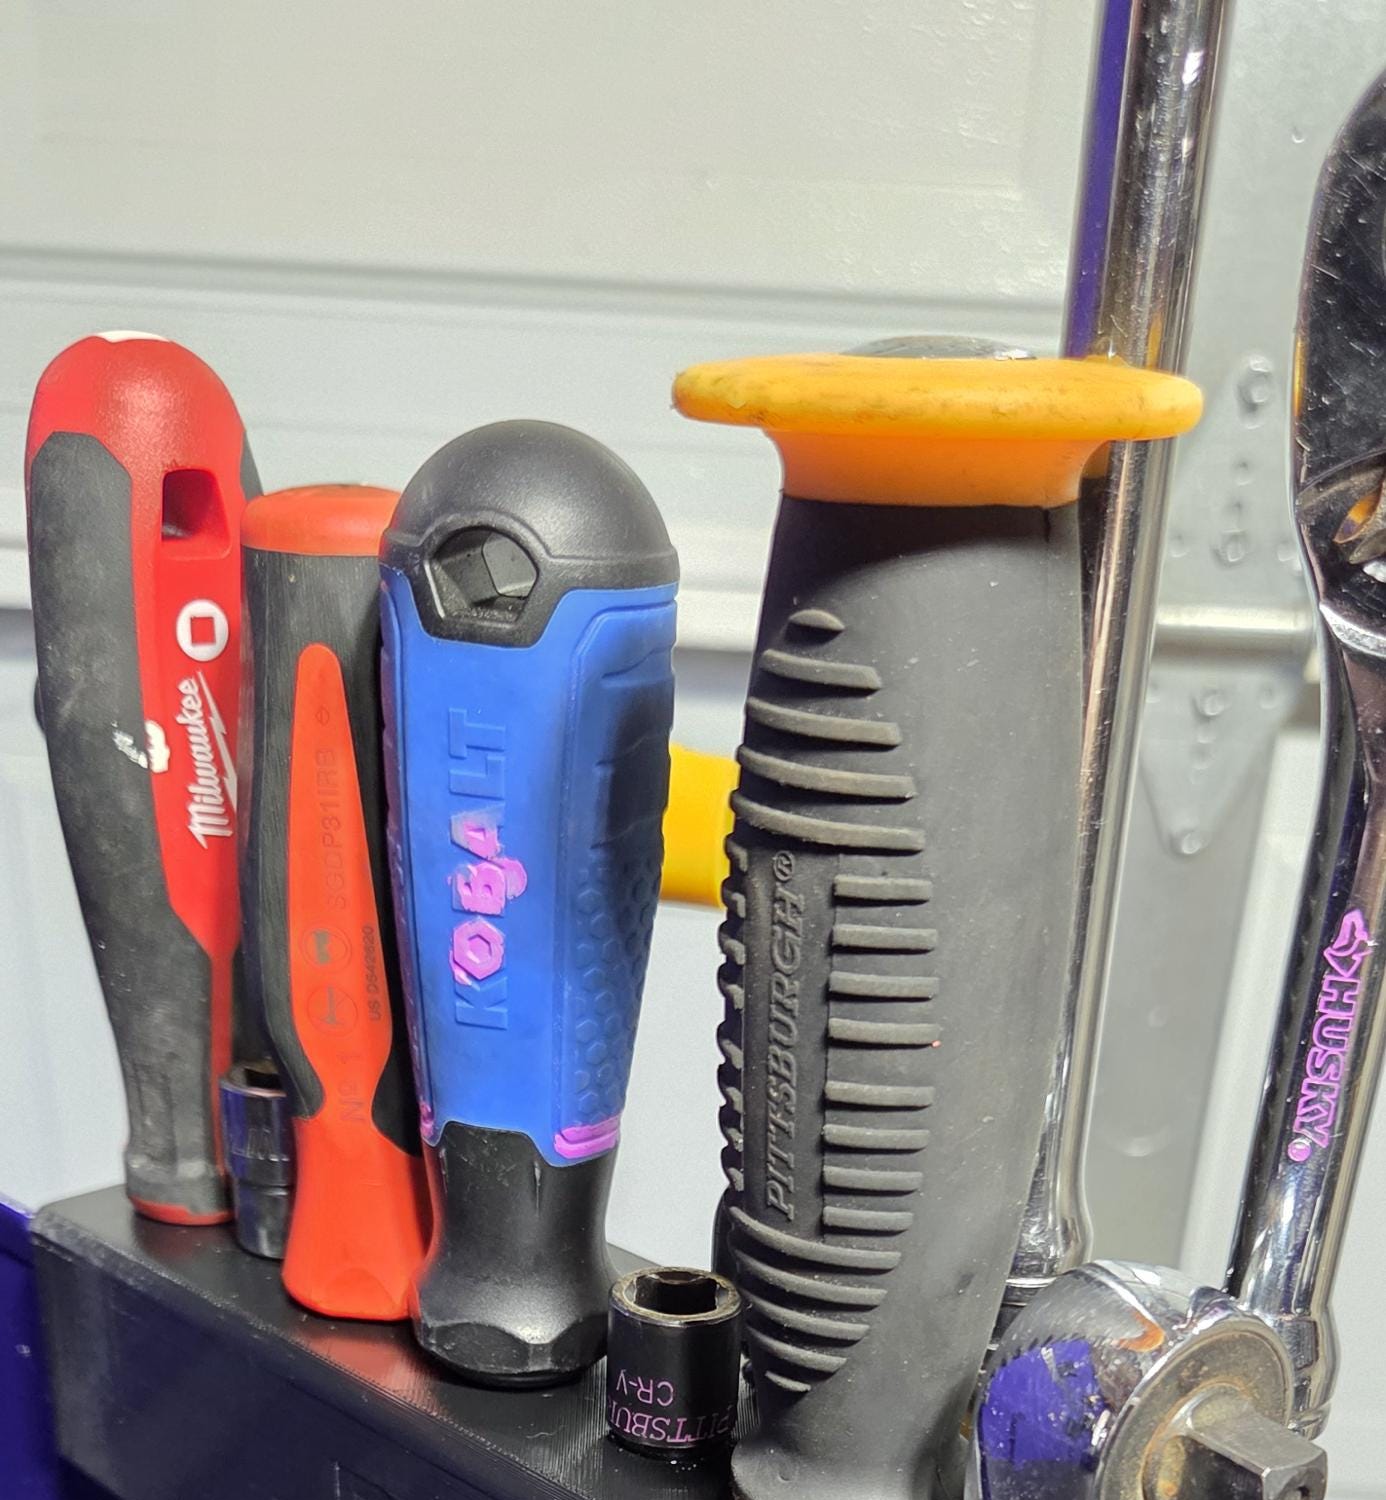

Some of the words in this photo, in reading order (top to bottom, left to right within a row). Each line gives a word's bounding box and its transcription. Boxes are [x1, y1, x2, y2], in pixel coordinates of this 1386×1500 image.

[175, 677, 233, 849] Milwaukee
[448, 707, 508, 1030] KOBALT
[367, 1000, 381, 1021] US
[1292, 976, 1361, 1147] HUSKY
[615, 1369, 674, 1407] CR-V
